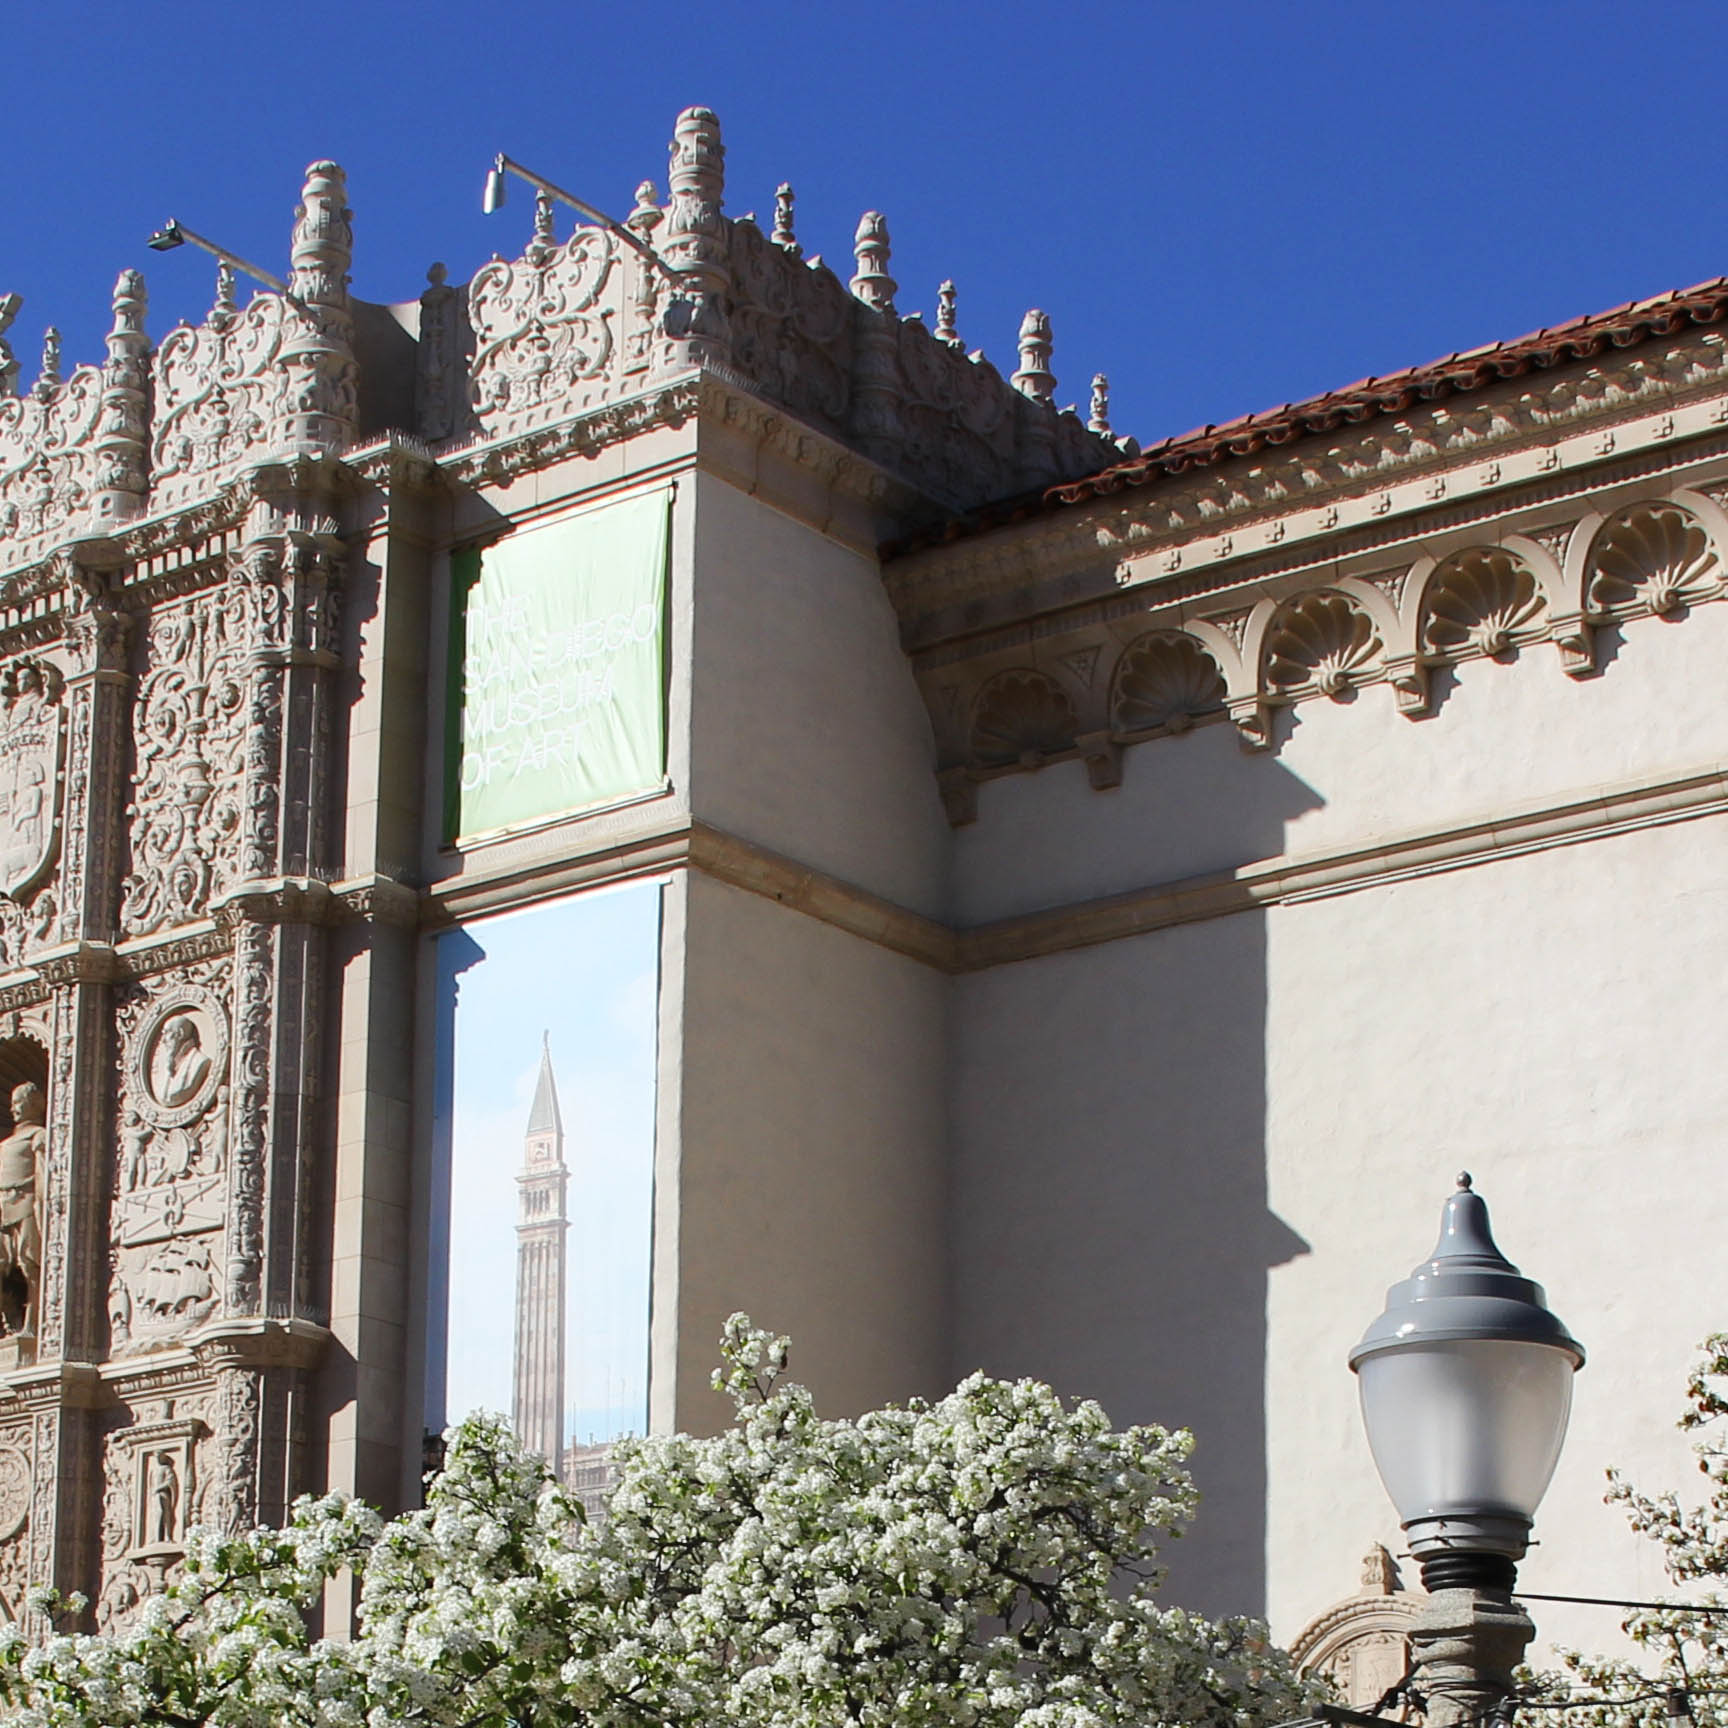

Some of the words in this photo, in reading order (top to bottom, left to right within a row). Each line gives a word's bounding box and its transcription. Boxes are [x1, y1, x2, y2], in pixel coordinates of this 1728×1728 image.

[461, 640, 532, 695] SAN
[546, 603, 657, 668] DIEGO
[462, 594, 529, 648] THE
[460, 666, 613, 742] MUSEUM
[458, 744, 509, 791] OF
[511, 719, 590, 783] ART
